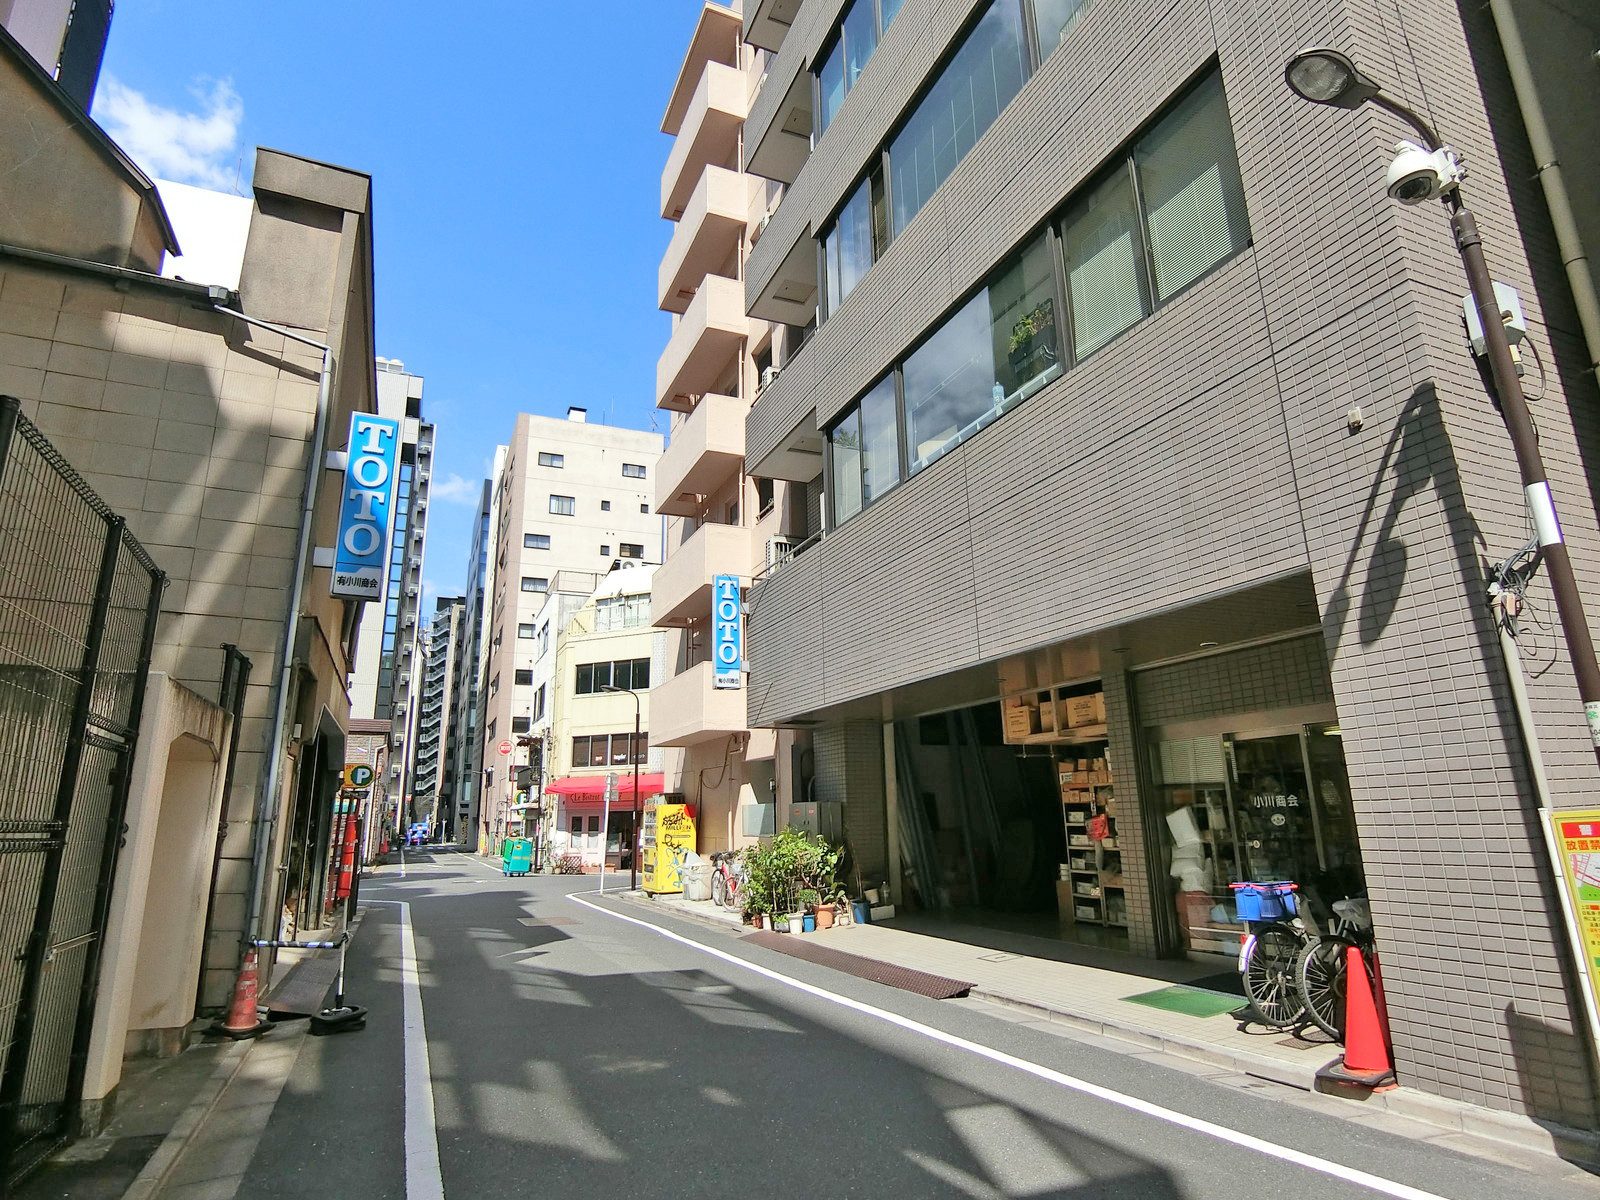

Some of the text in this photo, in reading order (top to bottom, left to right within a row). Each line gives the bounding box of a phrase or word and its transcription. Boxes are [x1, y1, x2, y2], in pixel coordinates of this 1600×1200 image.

[344, 421, 394, 557] TOTO
[718, 579, 738, 665] TOTO
[356, 768, 371, 784] P
[1253, 794, 1299, 808] 小川商会
